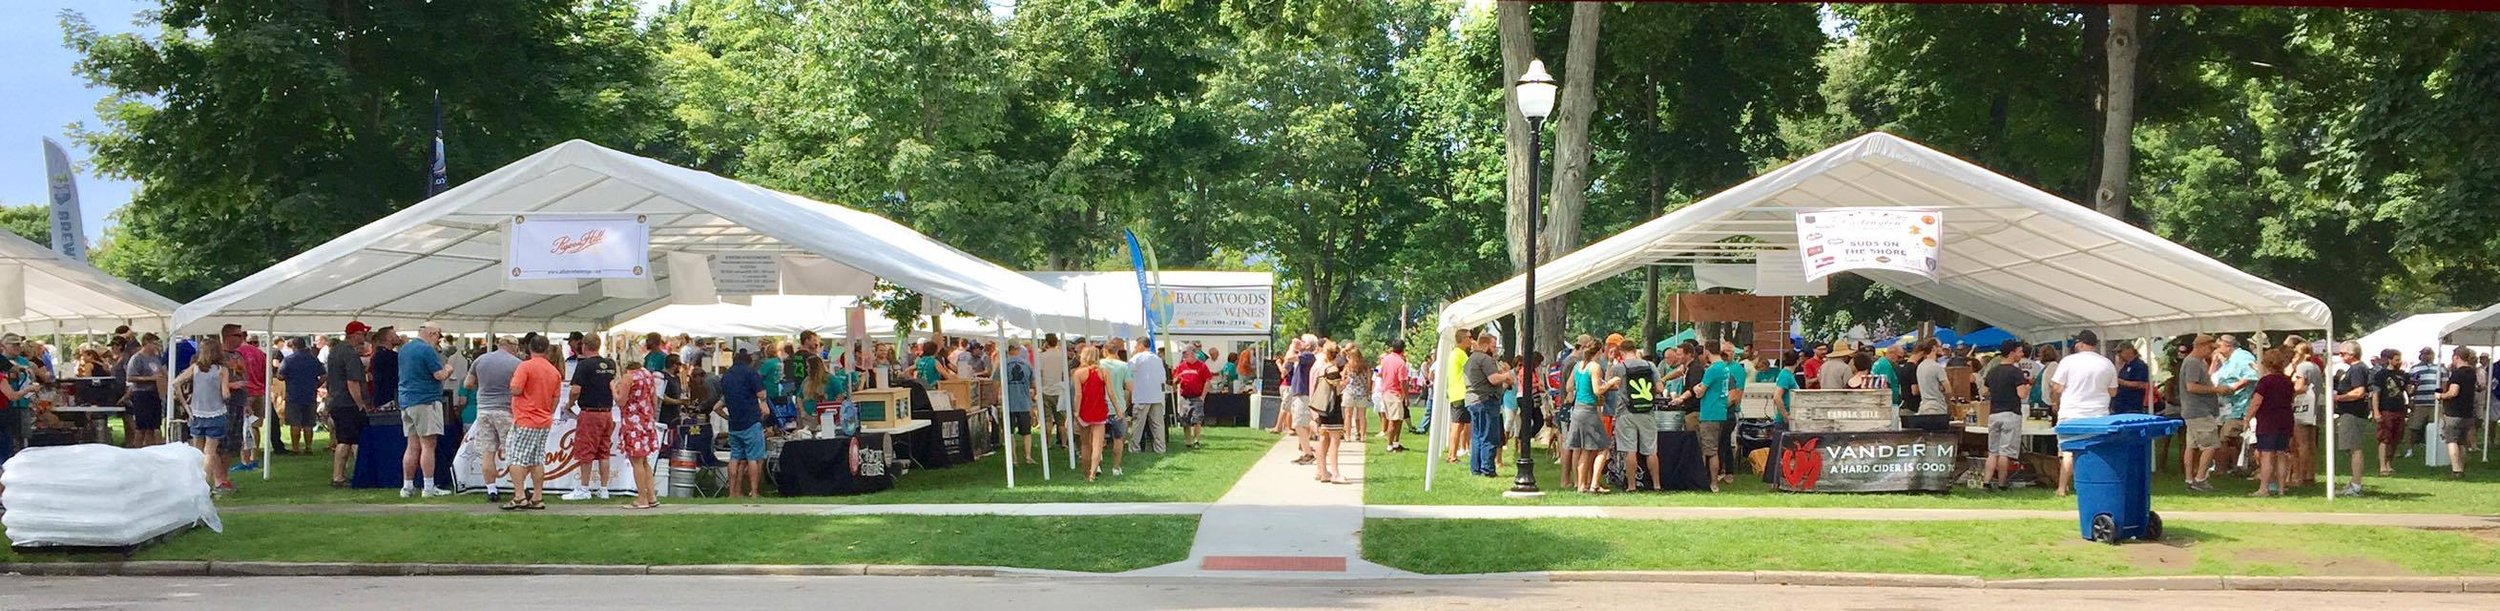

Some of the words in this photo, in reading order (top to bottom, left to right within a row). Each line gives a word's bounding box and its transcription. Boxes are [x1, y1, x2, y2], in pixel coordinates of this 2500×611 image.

[1869, 248, 1907, 256] SHORE
[1176, 292, 1266, 305] BACKWOODS
[1224, 307, 1265, 318] WINES
[1826, 443, 1926, 459] VANDER
[1937, 443, 1954, 458] M
[1829, 464, 1839, 474] A
[1840, 464, 1871, 474] HARD
[1872, 463, 1902, 473] CIDER
[1903, 462, 1915, 473] IS
[1916, 462, 1946, 473] GOOD
